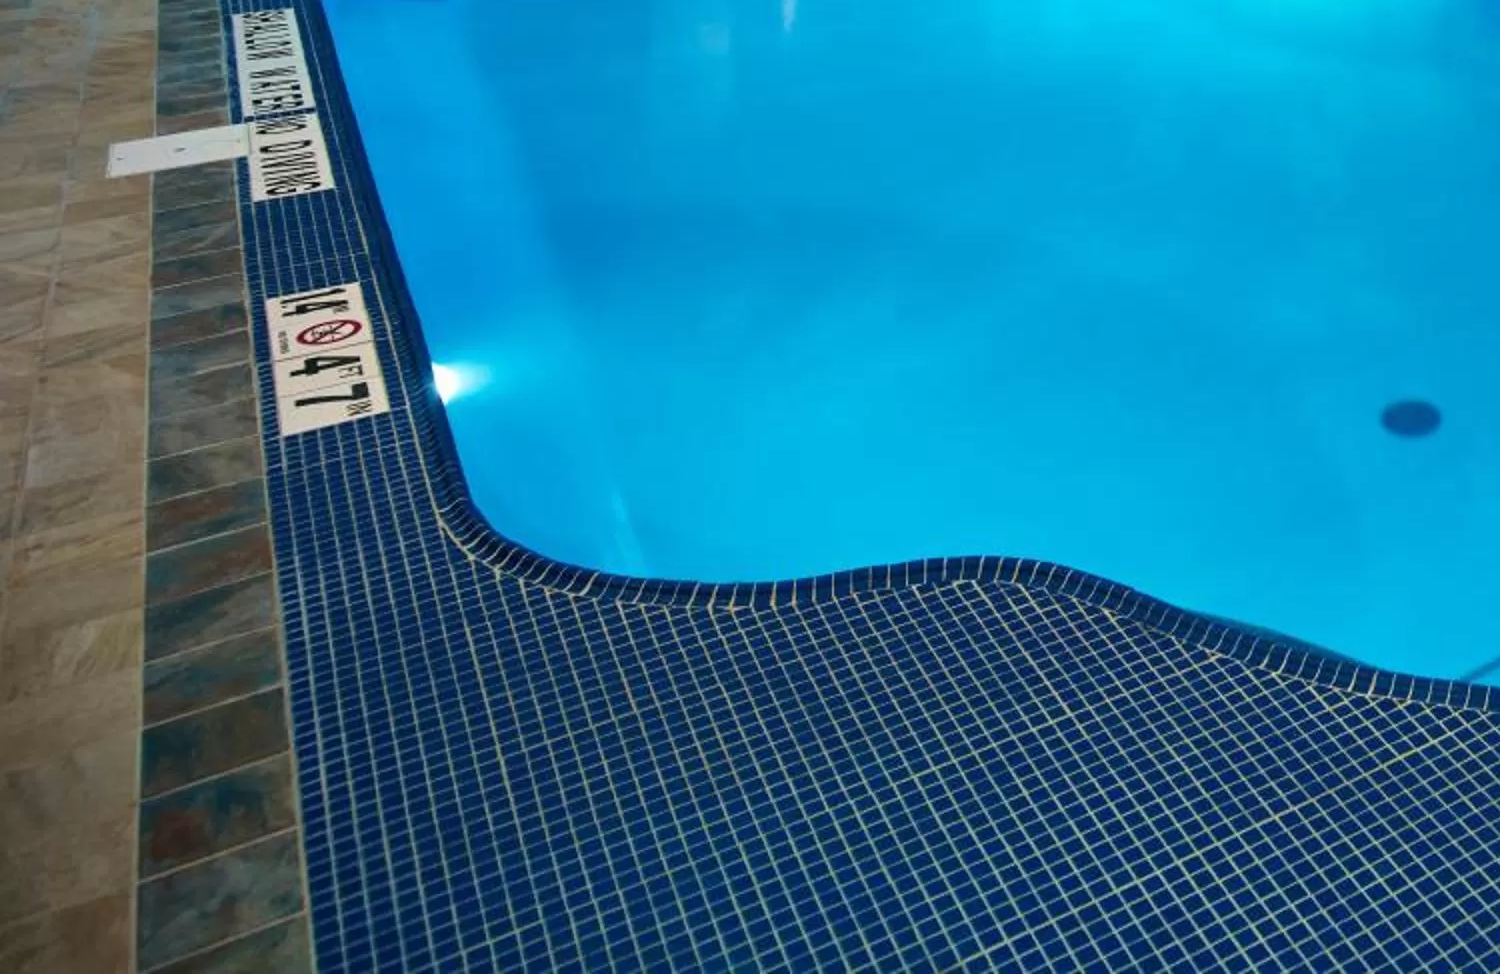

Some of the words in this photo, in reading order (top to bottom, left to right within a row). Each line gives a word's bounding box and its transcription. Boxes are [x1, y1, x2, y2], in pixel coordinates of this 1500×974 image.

[250, 65, 305, 114] WATER
[259, 139, 322, 197] DIVING
[289, 356, 362, 378] 4
[294, 381, 370, 407] 7
